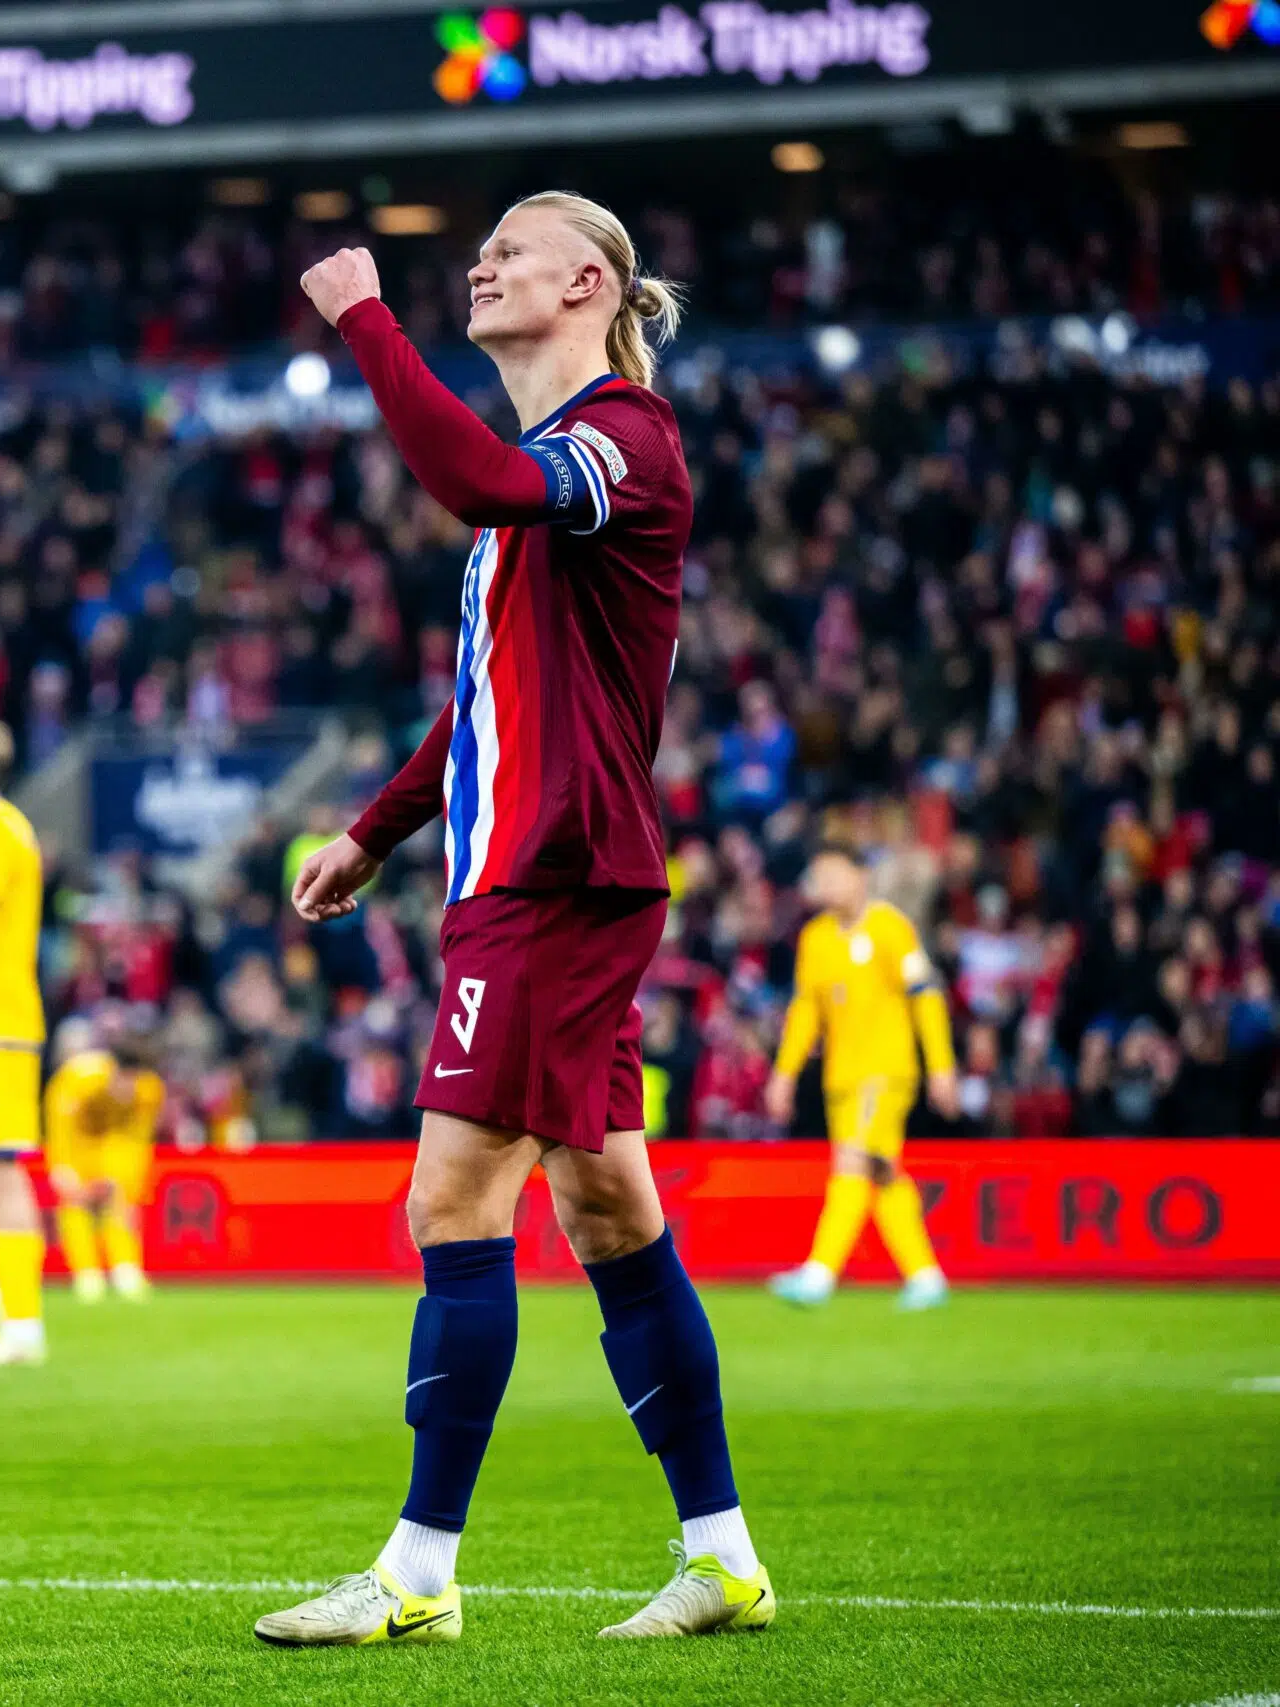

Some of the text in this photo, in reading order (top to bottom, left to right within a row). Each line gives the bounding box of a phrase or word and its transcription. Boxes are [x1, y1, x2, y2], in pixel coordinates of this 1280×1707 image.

[531, 0, 928, 84] Norsk Tipping
[547, 452, 570, 508] RESPECT
[450, 977, 486, 1055] 9
